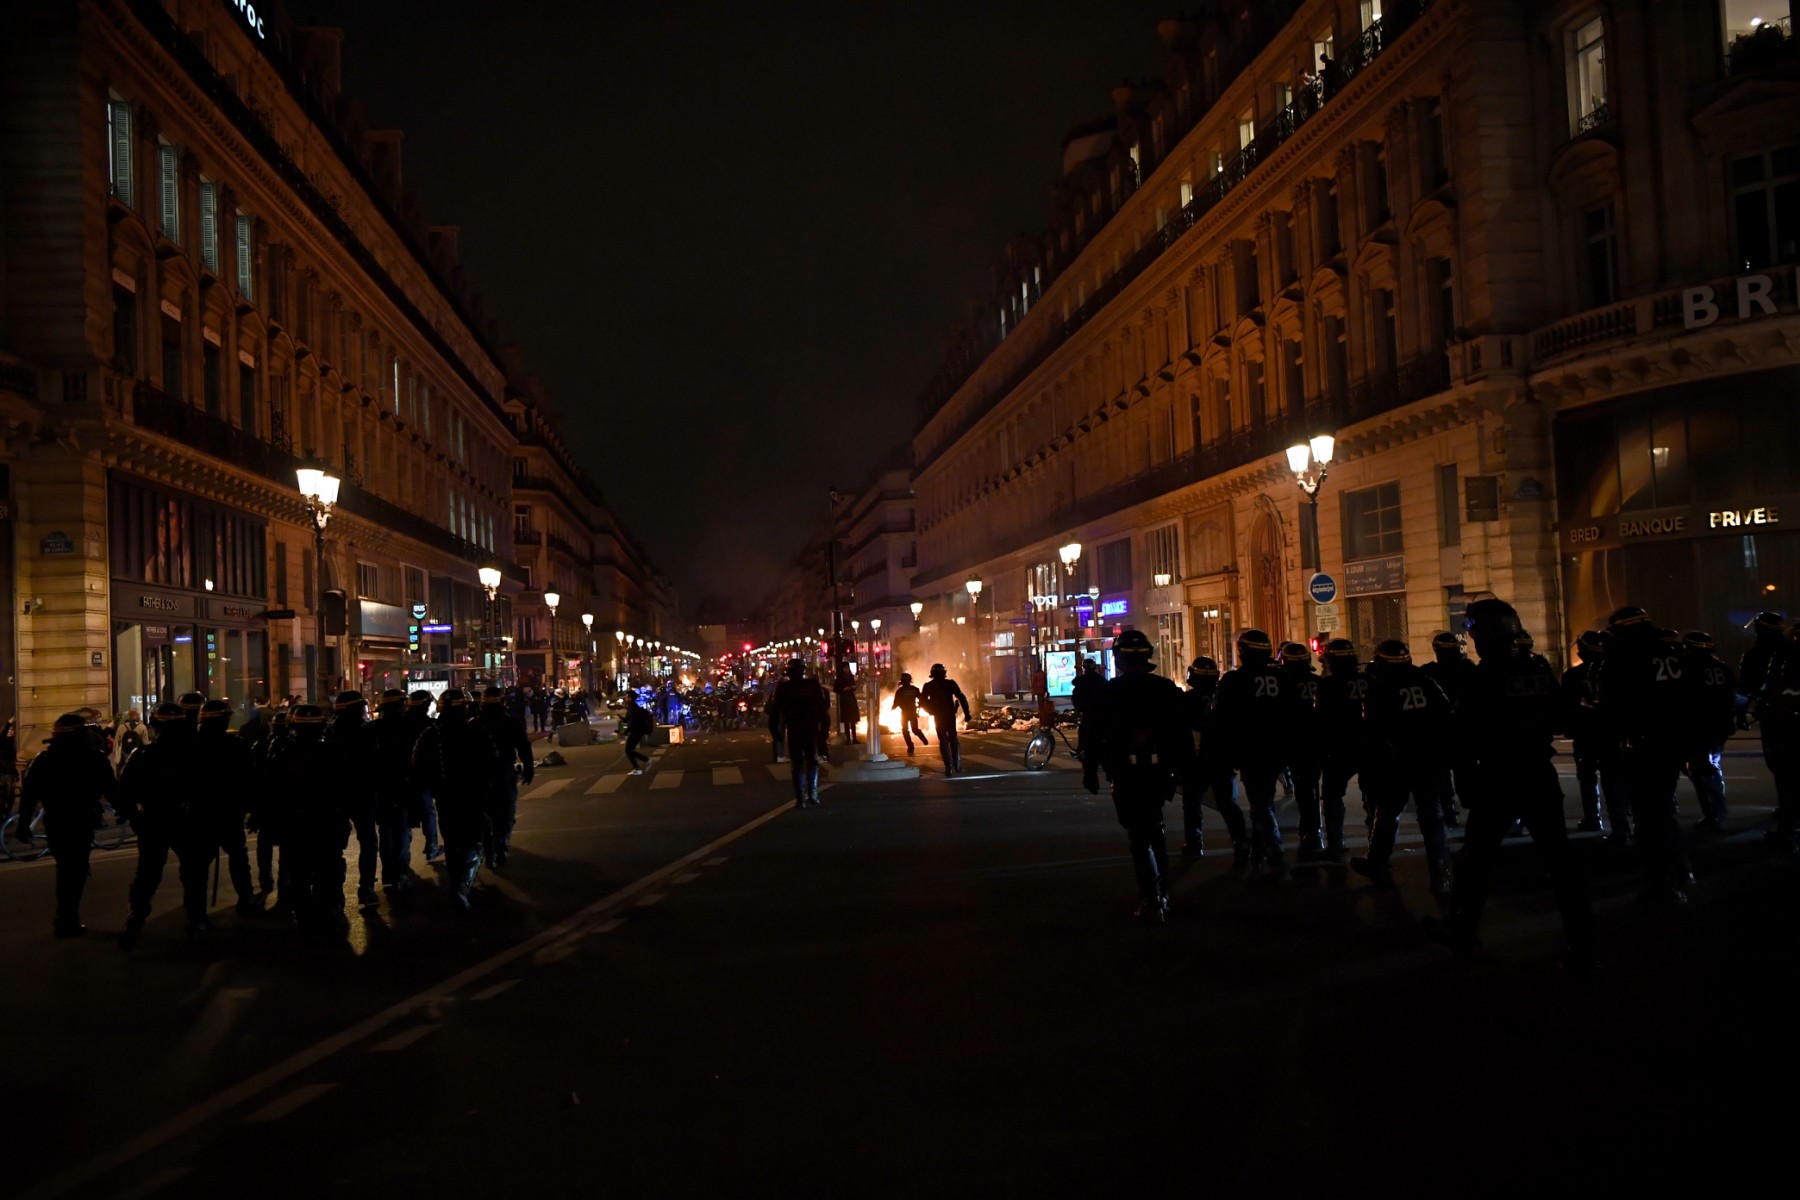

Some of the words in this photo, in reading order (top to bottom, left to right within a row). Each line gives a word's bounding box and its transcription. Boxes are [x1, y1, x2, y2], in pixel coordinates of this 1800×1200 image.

[1682, 266, 1800, 331] BR
[1570, 526, 1600, 544] BRED
[1620, 516, 1686, 538] BANQUE
[143, 596, 162, 610] FATHER
[1652, 656, 1682, 682] 2C
[1704, 666, 1727, 688] 3B
[409, 681, 447, 691] HUBLOT
[1254, 674, 1281, 698] 2B
[1399, 685, 1427, 711] 2B
